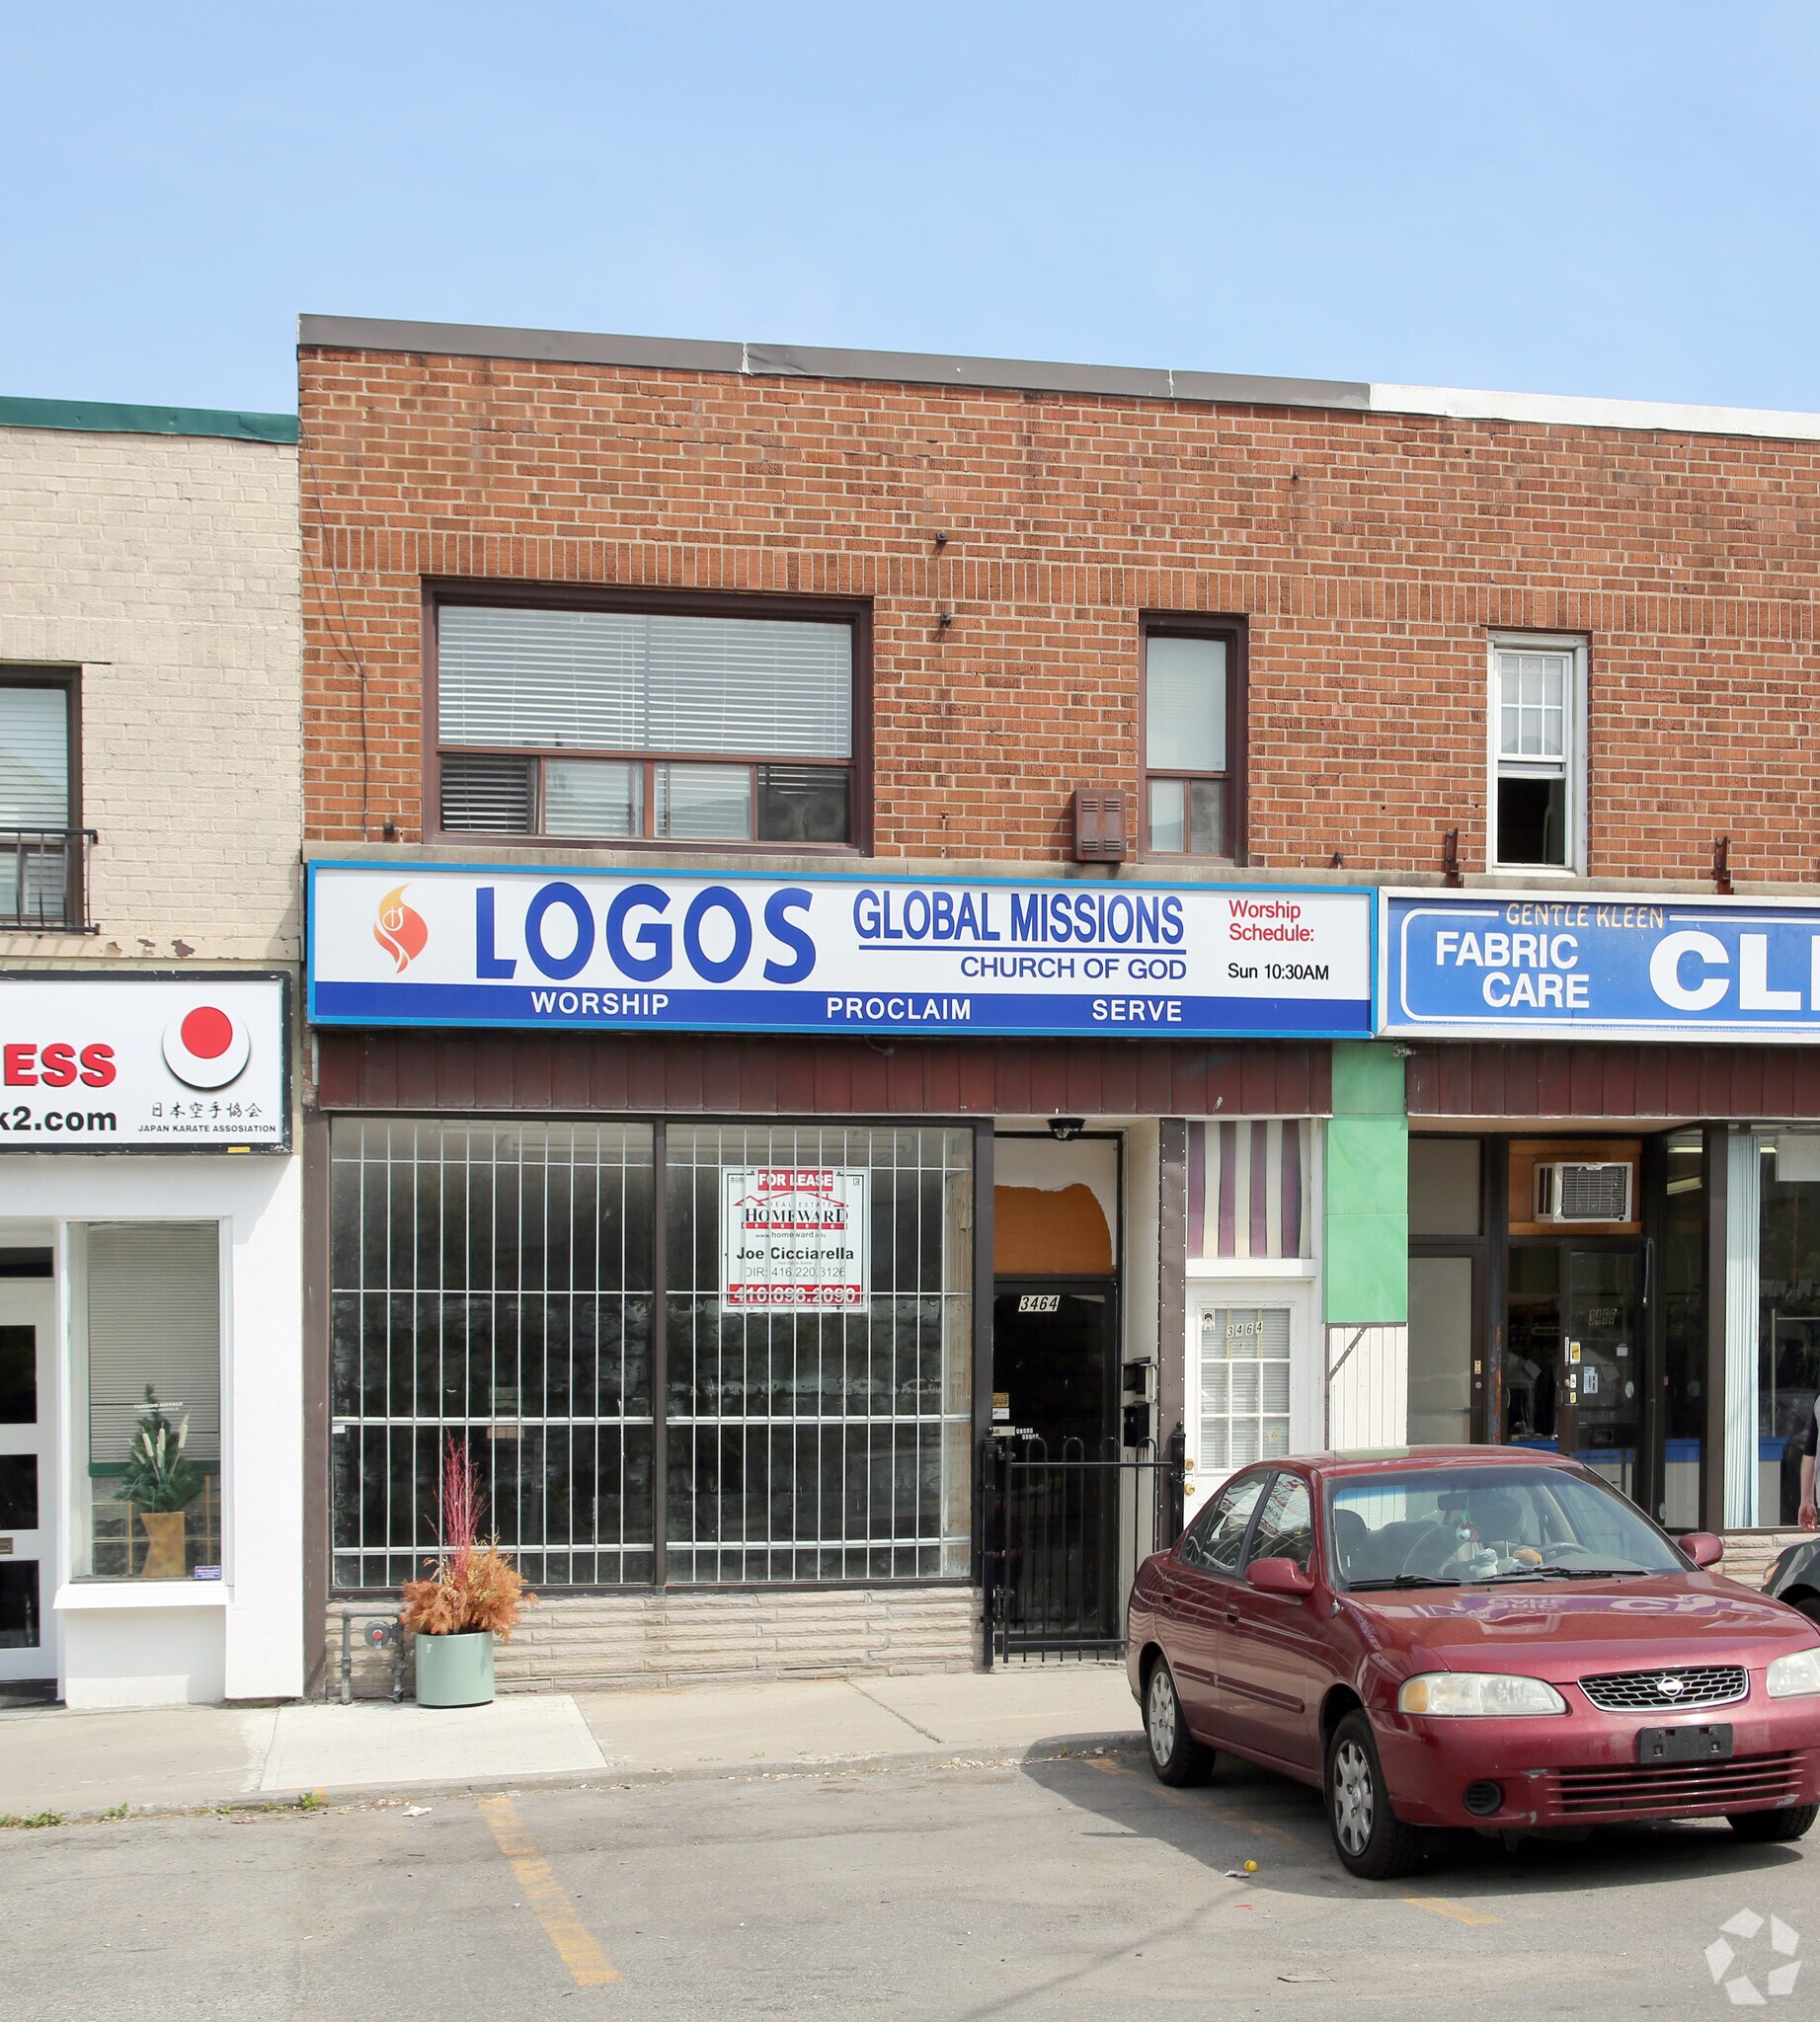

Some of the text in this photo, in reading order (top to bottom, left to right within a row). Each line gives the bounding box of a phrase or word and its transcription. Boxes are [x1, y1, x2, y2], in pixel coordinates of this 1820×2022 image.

[853, 889, 1184, 944] GLOBAL MISSIONS
[1228, 899, 1301, 923] Worship
[1506, 902, 1664, 929] GENTLE KLEEN
[476, 881, 817, 984] LOGOS
[1229, 923, 1314, 942] Schedule:
[1436, 931, 1579, 970] FABRIC
[960, 956, 1187, 979] CHURCH OF GOD
[1227, 963, 1329, 979] Sun 10:30AM
[1482, 972, 1590, 1008] CARE
[530, 990, 670, 1016] WORSHIP
[826, 997, 971, 1021] PROCLAIM
[1091, 998, 1182, 1022] SERVE
[4, 1043, 117, 1087] ESS
[759, 1173, 832, 1187] FOR LEASE
[736, 1246, 854, 1260] Joe Cicciarella
[735, 1286, 856, 1302] 416698.2090
[1020, 1296, 1058, 1311] 3464
[1227, 1321, 1262, 1337] 3464
